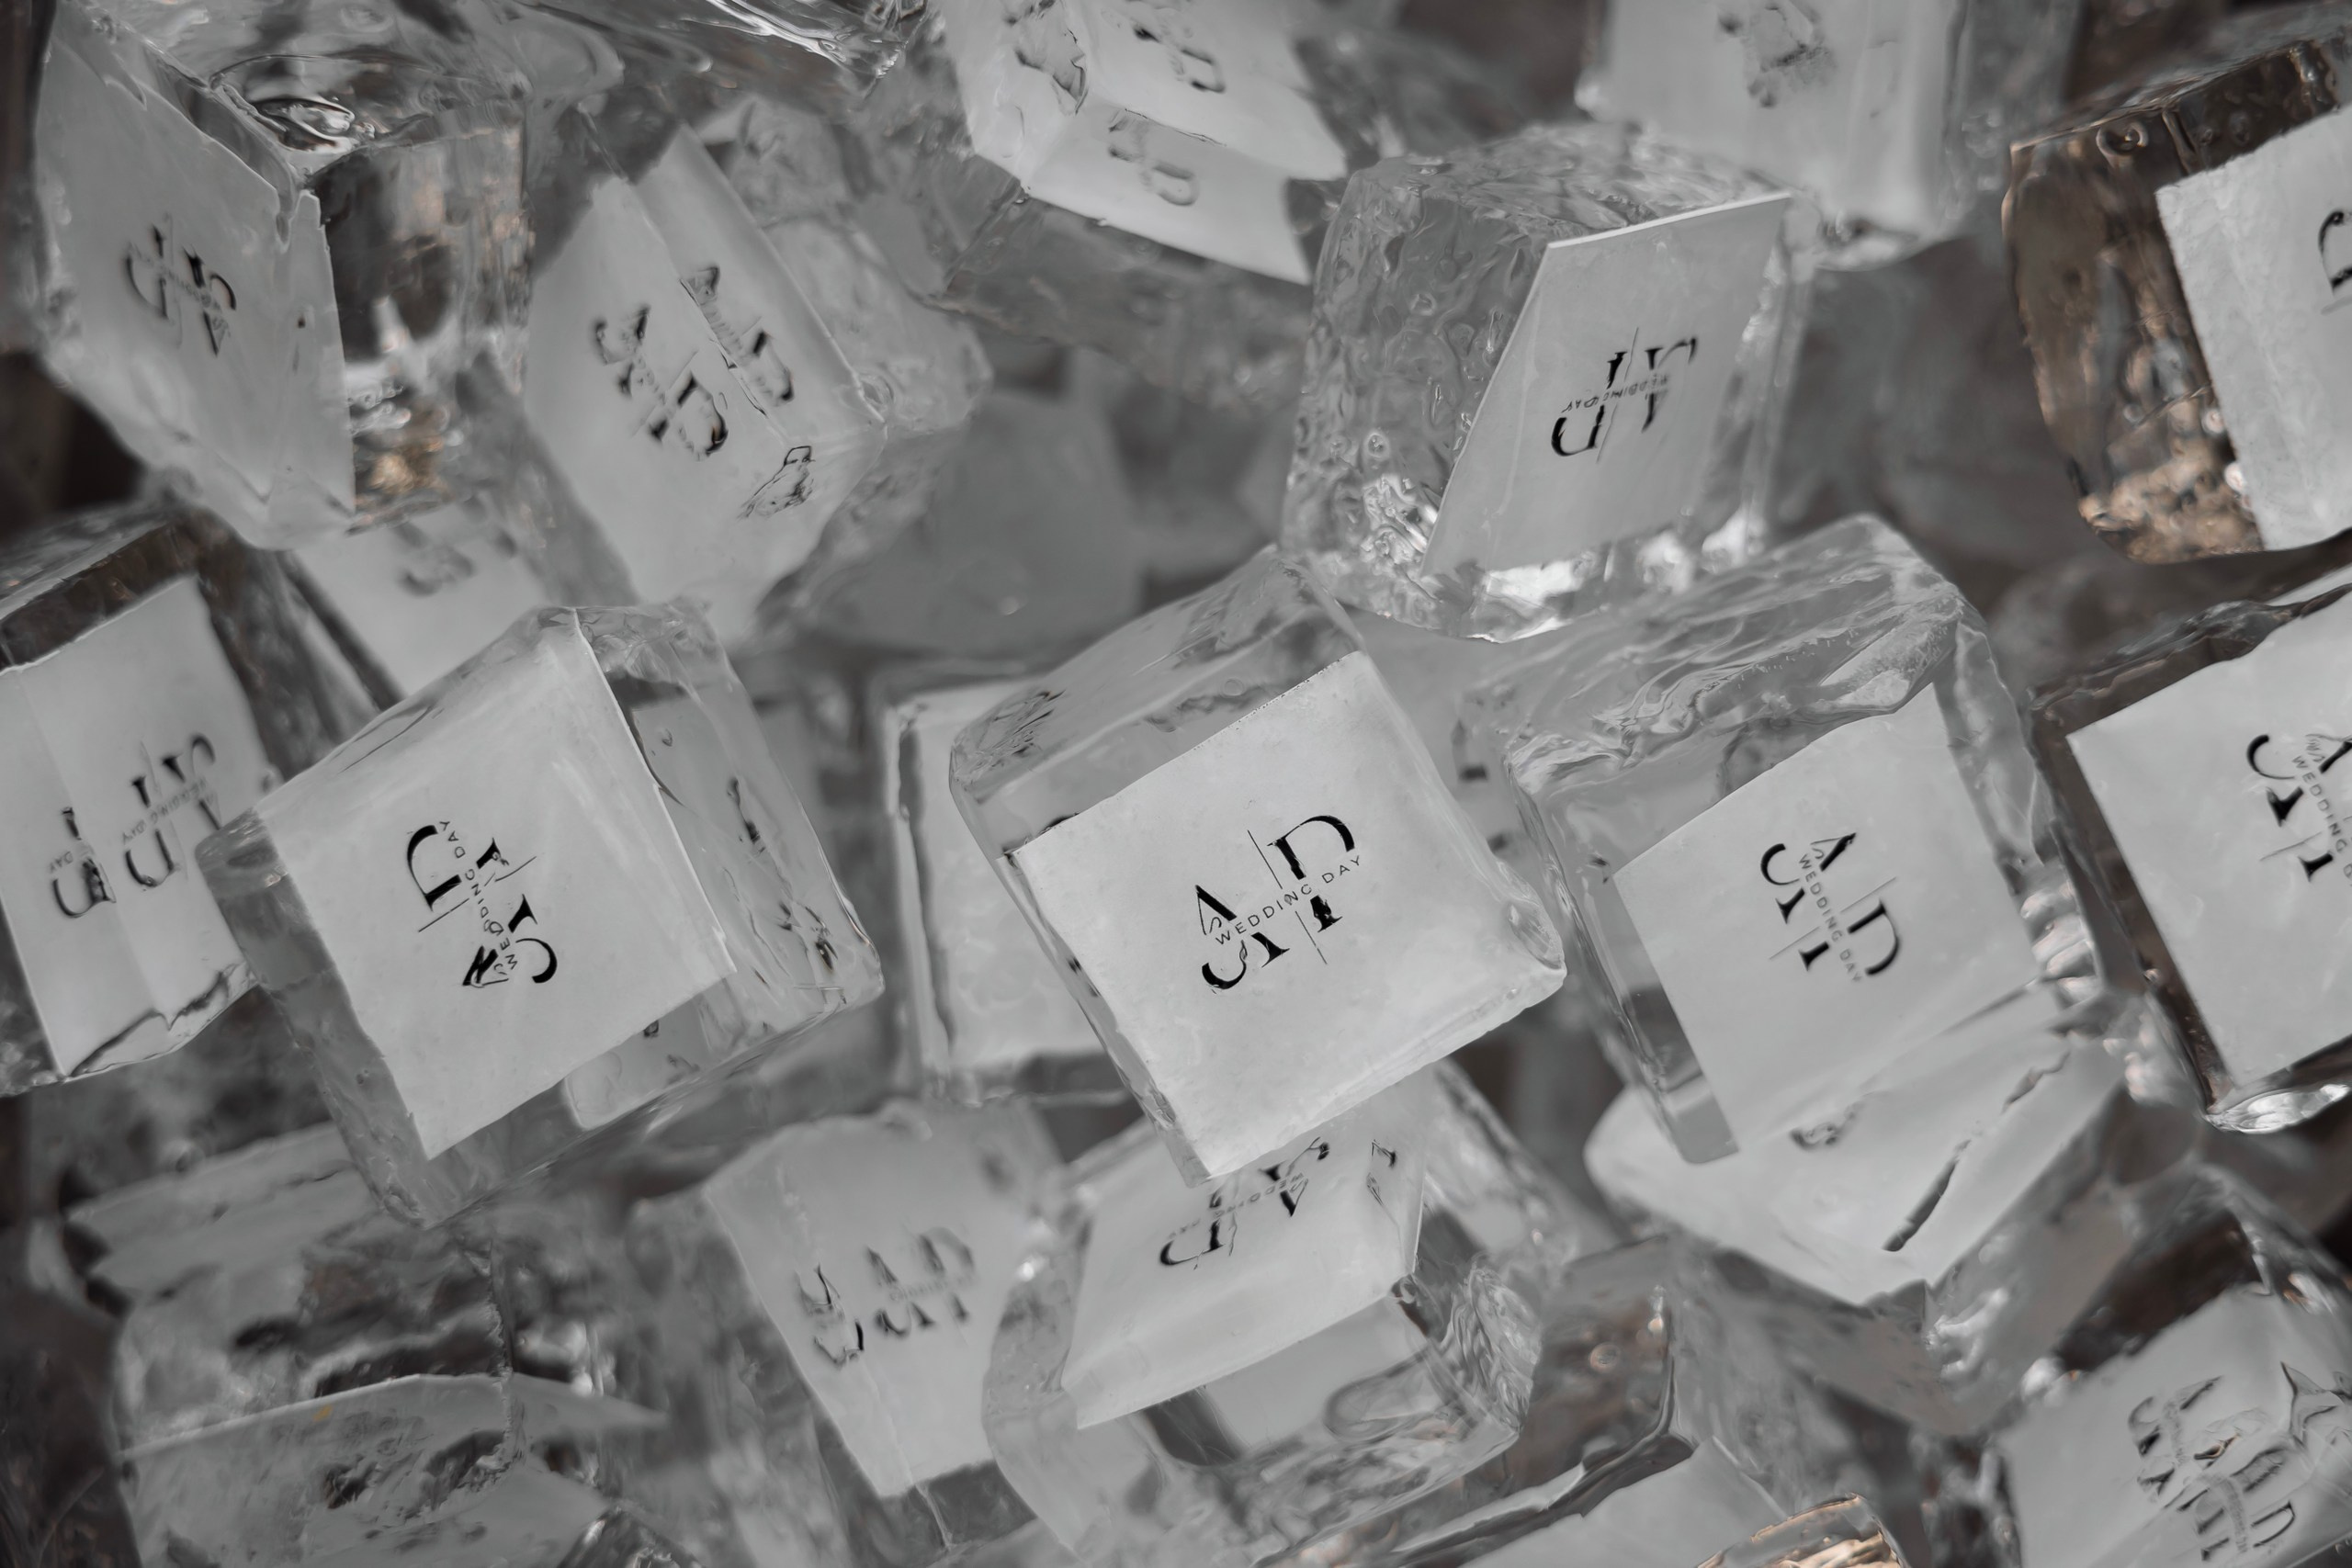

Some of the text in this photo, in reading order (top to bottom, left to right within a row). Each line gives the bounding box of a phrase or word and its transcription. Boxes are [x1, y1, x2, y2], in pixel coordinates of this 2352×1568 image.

[439, 820, 466, 859] DAY
[1215, 854, 1361, 945] WEDDING DAY
[1798, 853, 1863, 983] WEDDING DAY
